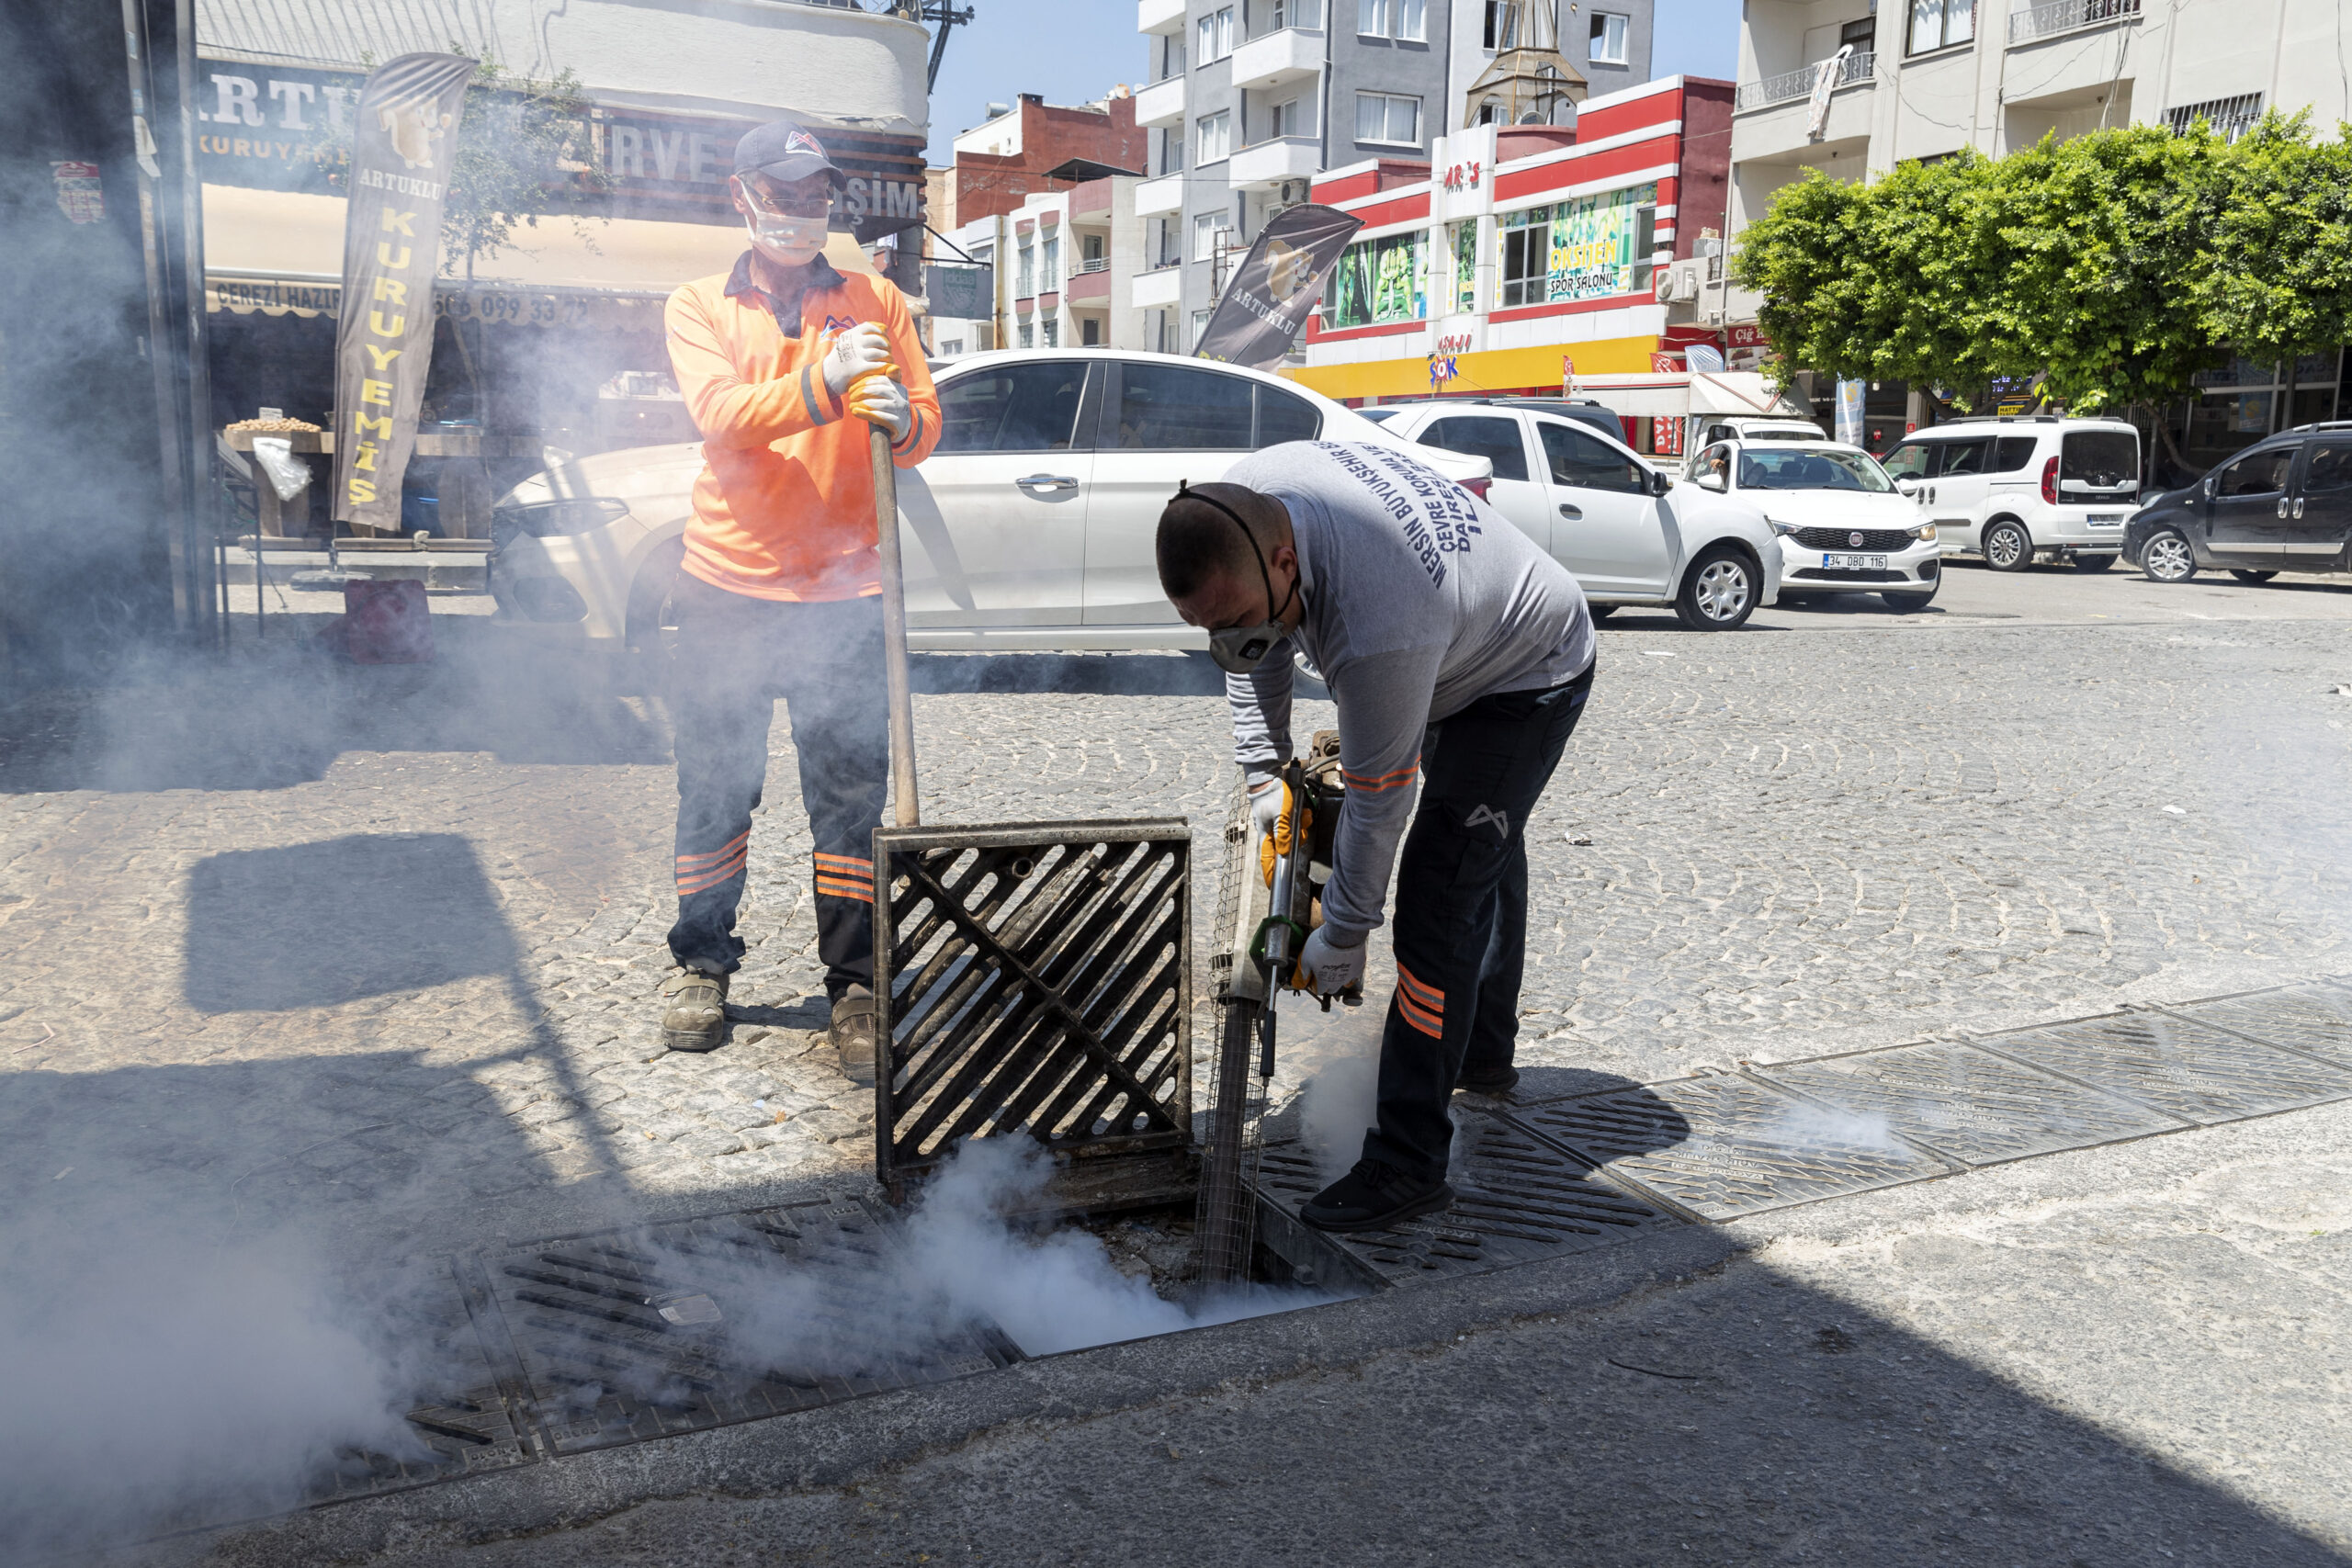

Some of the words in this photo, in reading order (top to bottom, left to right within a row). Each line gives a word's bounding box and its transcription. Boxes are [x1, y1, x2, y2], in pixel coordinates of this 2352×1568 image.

[358, 168, 442, 201] ARTUKLU
[217, 279, 282, 309] ÇEREZİ
[481, 295, 521, 320] 099
[530, 299, 556, 321] 33
[1551, 277, 1574, 293] SPOR
[1577, 272, 1613, 290] SALONU
[1231, 287, 1296, 336] ARTUKLU
[348, 206, 418, 506] KURUYEMİŞ
[1735, 326, 1755, 344] Çiğ
[1329, 448, 1414, 521] BÜYÜKŞEHİR
[1379, 457, 1437, 497] KORUMA
[1424, 501, 1458, 553] ÇEVRE
[1403, 516, 1447, 591] MERSİN
[1829, 556, 1841, 567] 34
[1870, 557, 1883, 568] 116
